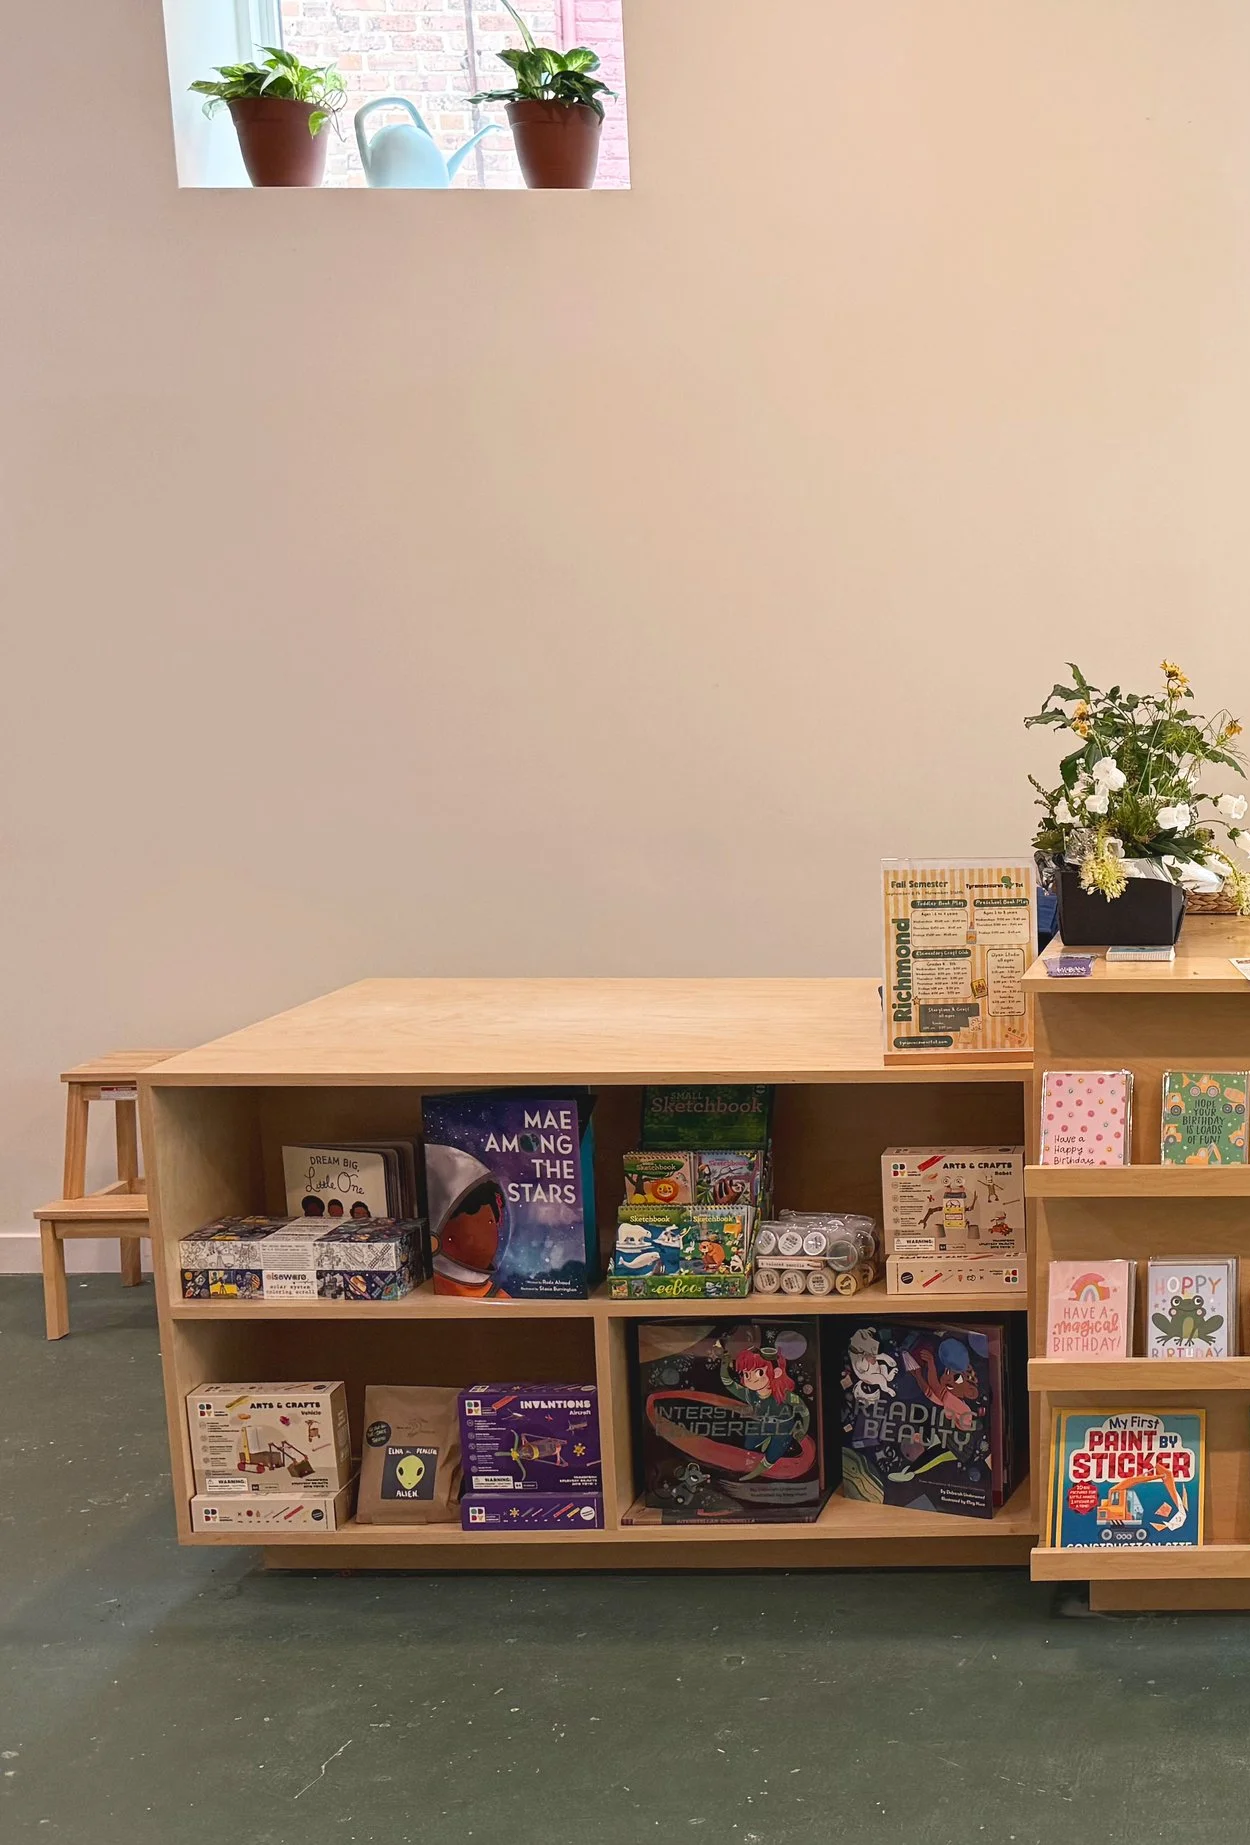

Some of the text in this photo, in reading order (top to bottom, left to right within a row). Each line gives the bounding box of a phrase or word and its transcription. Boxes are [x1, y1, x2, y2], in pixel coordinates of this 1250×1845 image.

[909, 880, 948, 888] Semester
[892, 918, 912, 1022] Richmond
[650, 1098, 763, 1114] Sketchbook
[1195, 1099, 1216, 1108] HOPE
[524, 1110, 572, 1130] MAE
[1194, 1108, 1217, 1117] YOUR
[1182, 1117, 1224, 1126] BIRTHDAY
[1186, 1125, 1223, 1135] IS LOADS
[1054, 1135, 1076, 1144] Have
[1188, 1134, 1221, 1145] OF FUN!
[1054, 1145, 1083, 1156] Happy
[310, 1156, 360, 1172] DREAM BIG,
[1054, 1156, 1095, 1165] Birthday
[531, 1160, 575, 1179] THE
[305, 1167, 365, 1195] Little One
[508, 1184, 576, 1204] STARS
[1154, 1275, 1221, 1294] HOPPY
[1063, 1307, 1108, 1318] HAVE A
[1052, 1312, 1120, 1338] magical
[1053, 1337, 1121, 1353] BIRTHDAY!
[520, 1400, 591, 1409] INVENTIONS
[1109, 1416, 1160, 1430] My First
[864, 1419, 970, 1452] BEAUTY
[1089, 1431, 1178, 1451] PAINT BY
[1072, 1452, 1193, 1479] STICKER
